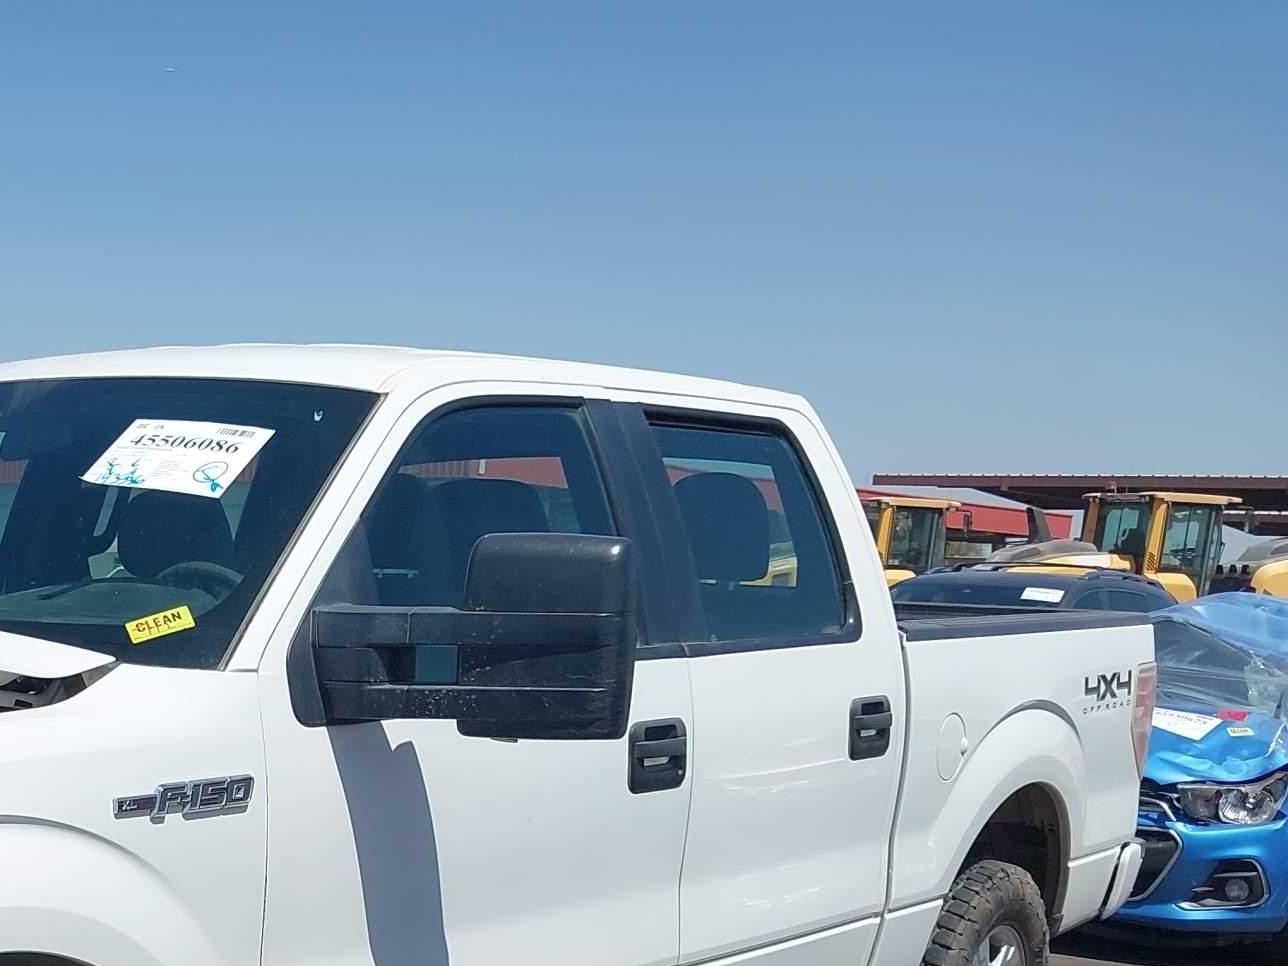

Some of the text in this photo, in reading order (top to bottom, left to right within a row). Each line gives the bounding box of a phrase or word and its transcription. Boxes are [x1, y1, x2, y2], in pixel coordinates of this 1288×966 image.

[130, 433, 243, 455] 45506086
[135, 611, 183, 633] CLEAN
[149, 773, 256, 824] F-150
